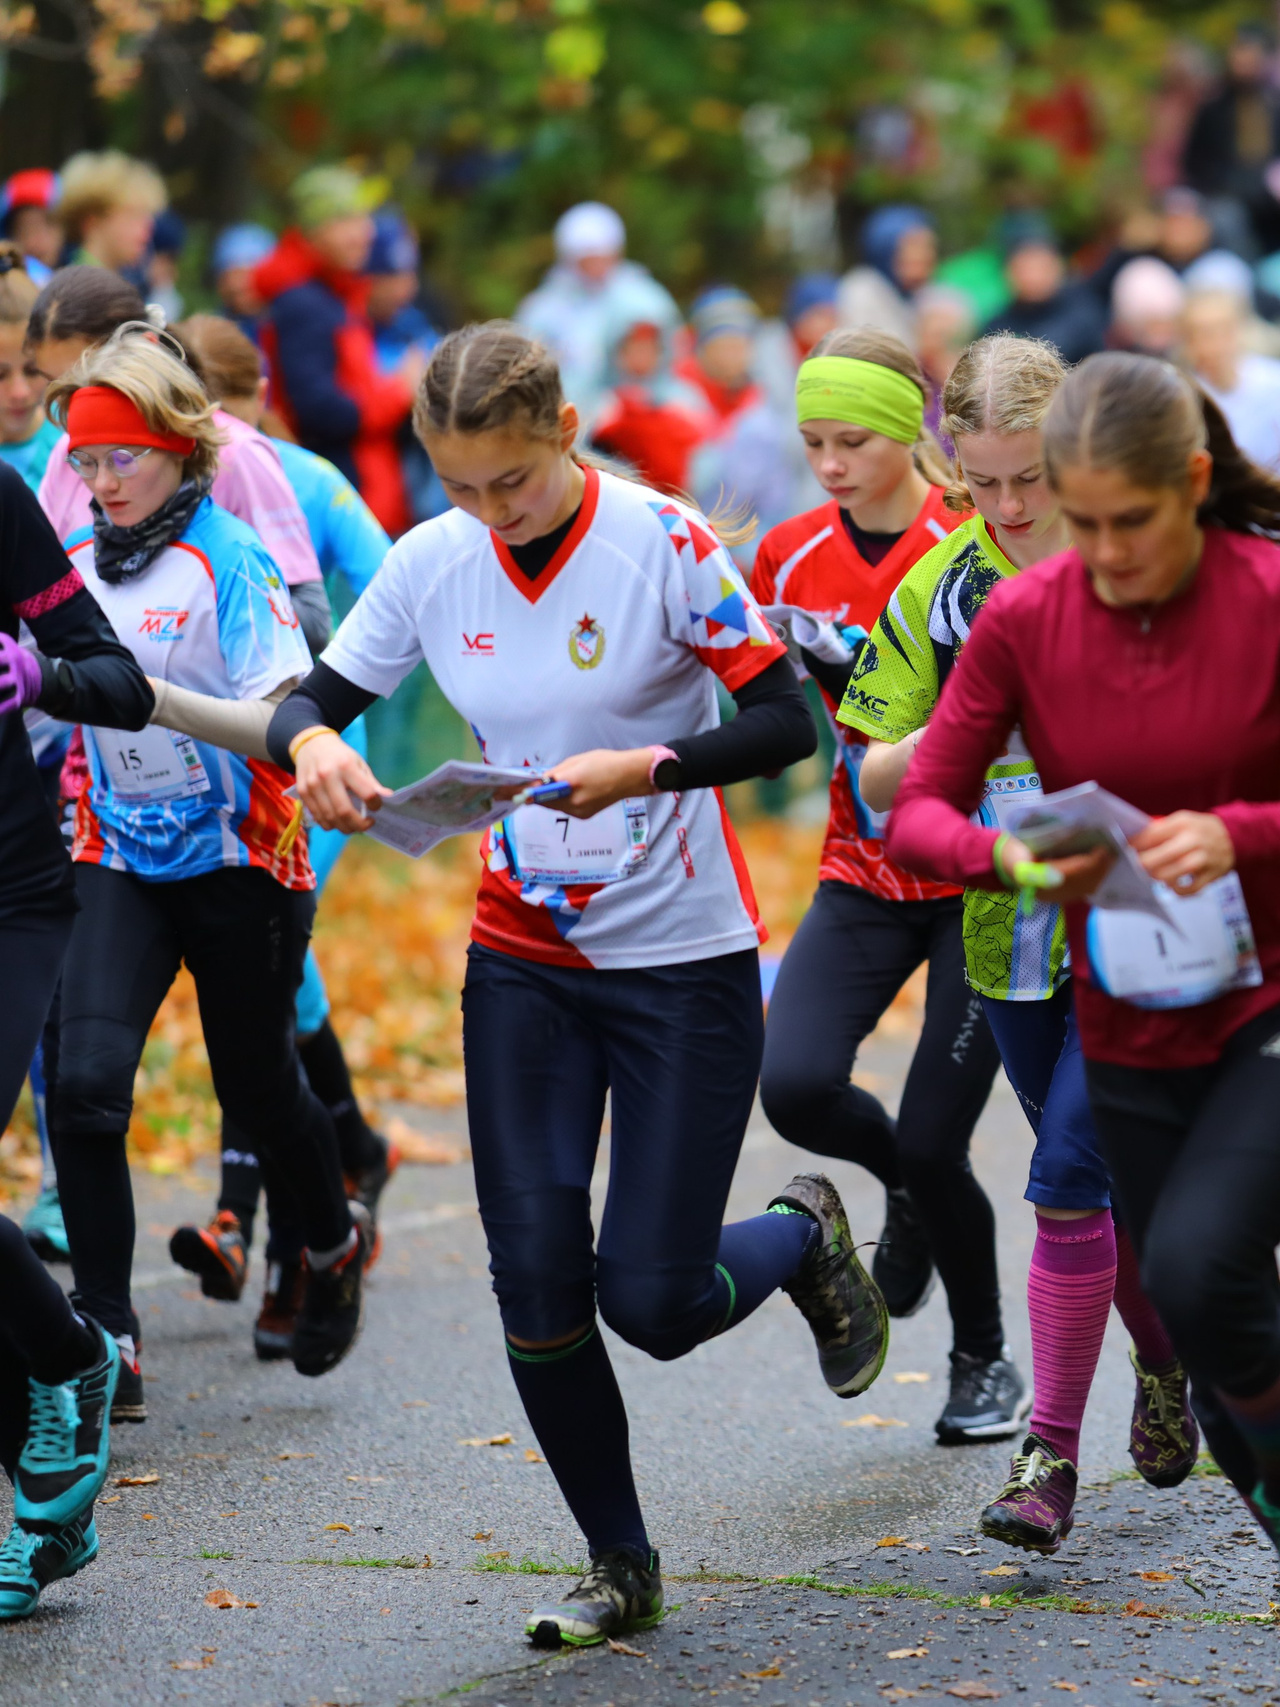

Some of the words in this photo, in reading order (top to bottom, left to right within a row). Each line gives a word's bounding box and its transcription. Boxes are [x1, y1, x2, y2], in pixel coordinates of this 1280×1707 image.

[462, 633, 494, 650] VC
[118, 748, 142, 771] 15
[556, 817, 569, 843] 7
[1155, 930, 1167, 958] 1
